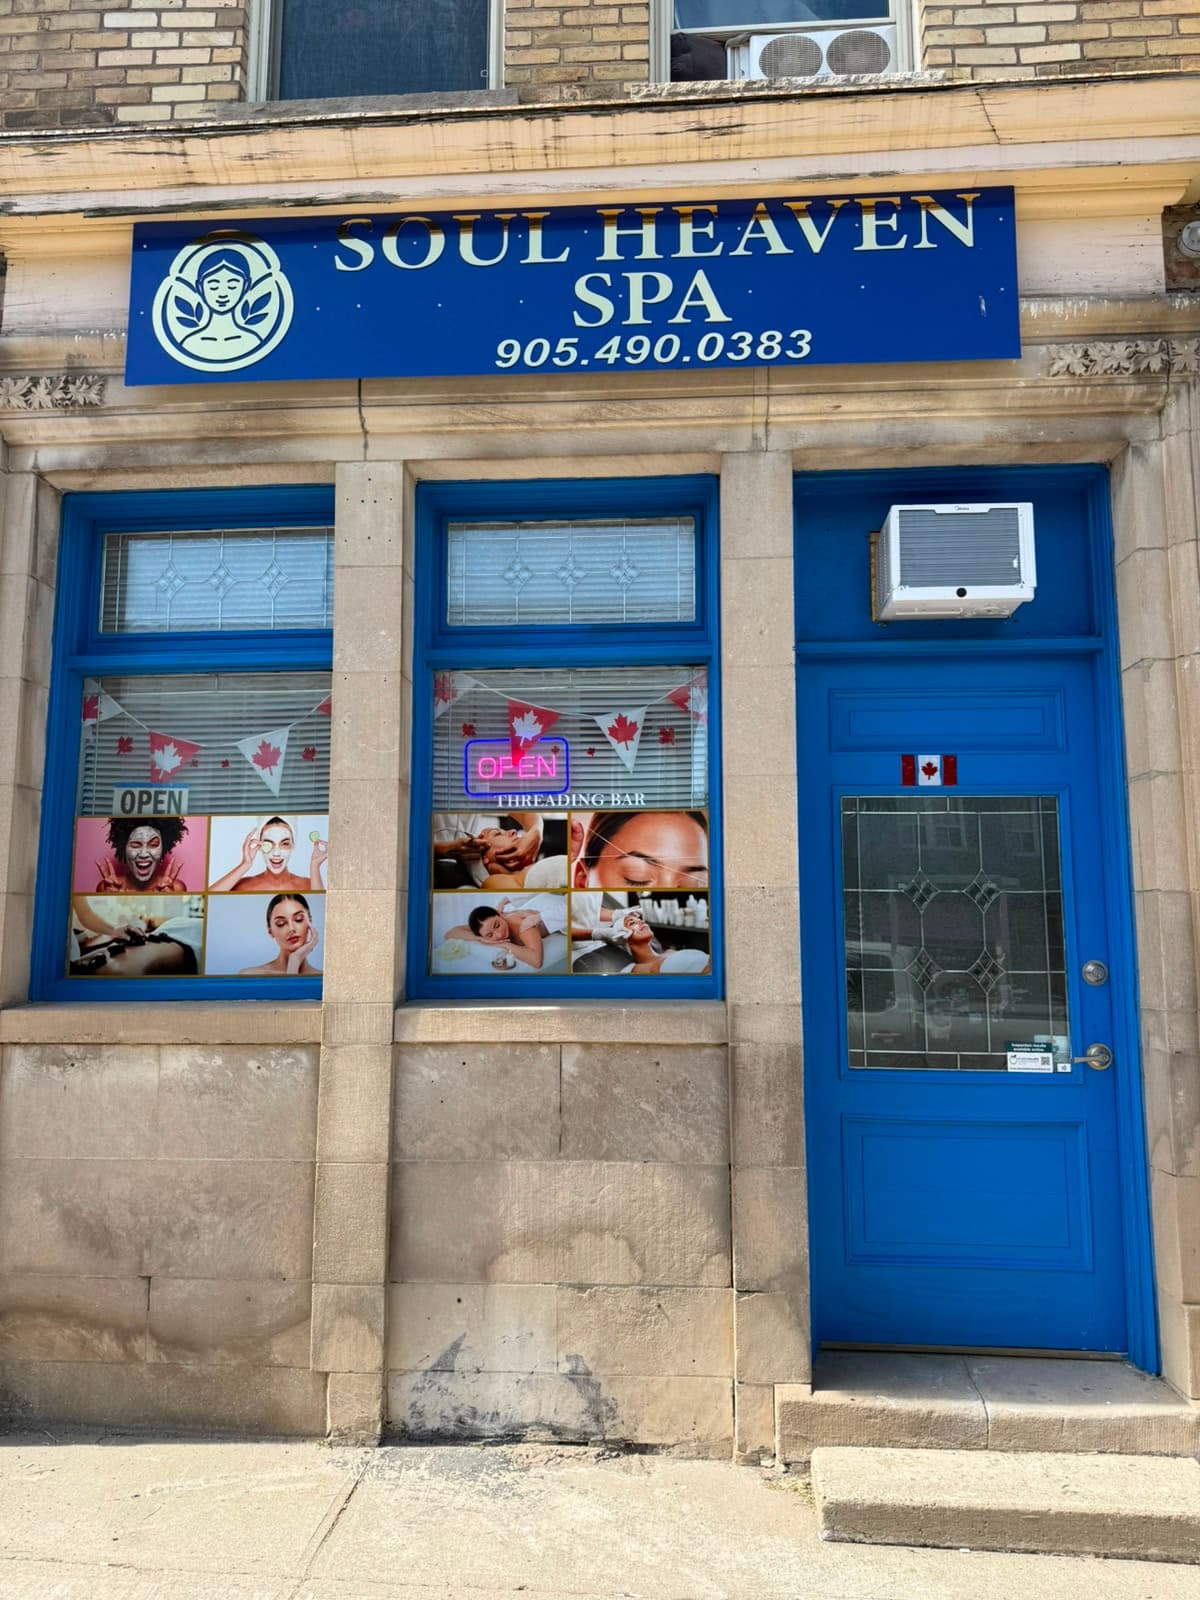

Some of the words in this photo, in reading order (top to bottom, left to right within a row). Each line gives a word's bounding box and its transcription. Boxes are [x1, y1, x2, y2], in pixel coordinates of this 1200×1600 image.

[334, 211, 570, 272] SOUL
[596, 193, 981, 260] HEAVEN
[573, 269, 732, 328] SPA
[495, 329, 812, 368] 905.490.0383
[478, 753, 556, 779] OPEN
[120, 789, 183, 815] OPEN
[494, 793, 604, 808] THREADING
[611, 792, 646, 807] BAR
